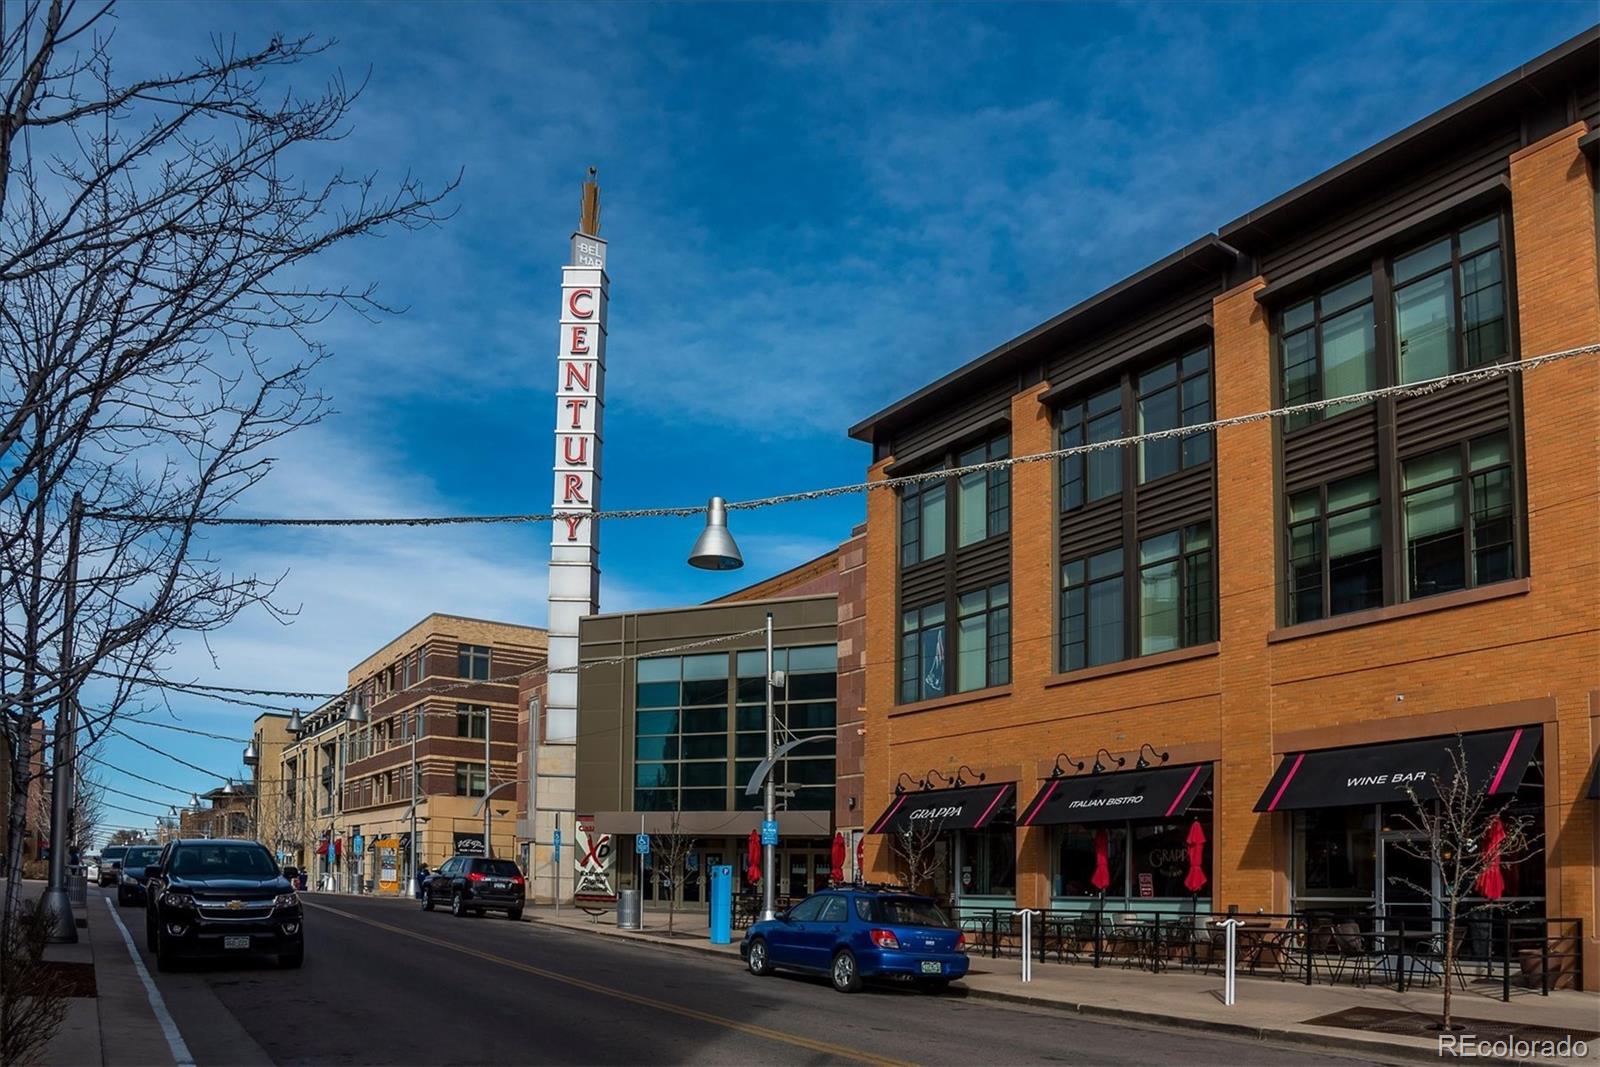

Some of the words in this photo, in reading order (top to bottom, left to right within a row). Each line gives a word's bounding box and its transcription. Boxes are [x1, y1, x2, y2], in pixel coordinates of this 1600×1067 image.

[579, 243, 602, 258] BEL
[563, 289, 594, 541] CENTURY
[1346, 774, 1388, 787] WINE
[1391, 771, 1427, 783] BAR
[1068, 799, 1107, 809] ITALIAN
[1106, 795, 1144, 806] BISTRO
[909, 806, 963, 820] GRAPPA
[1148, 847, 1189, 868] GRAPP
